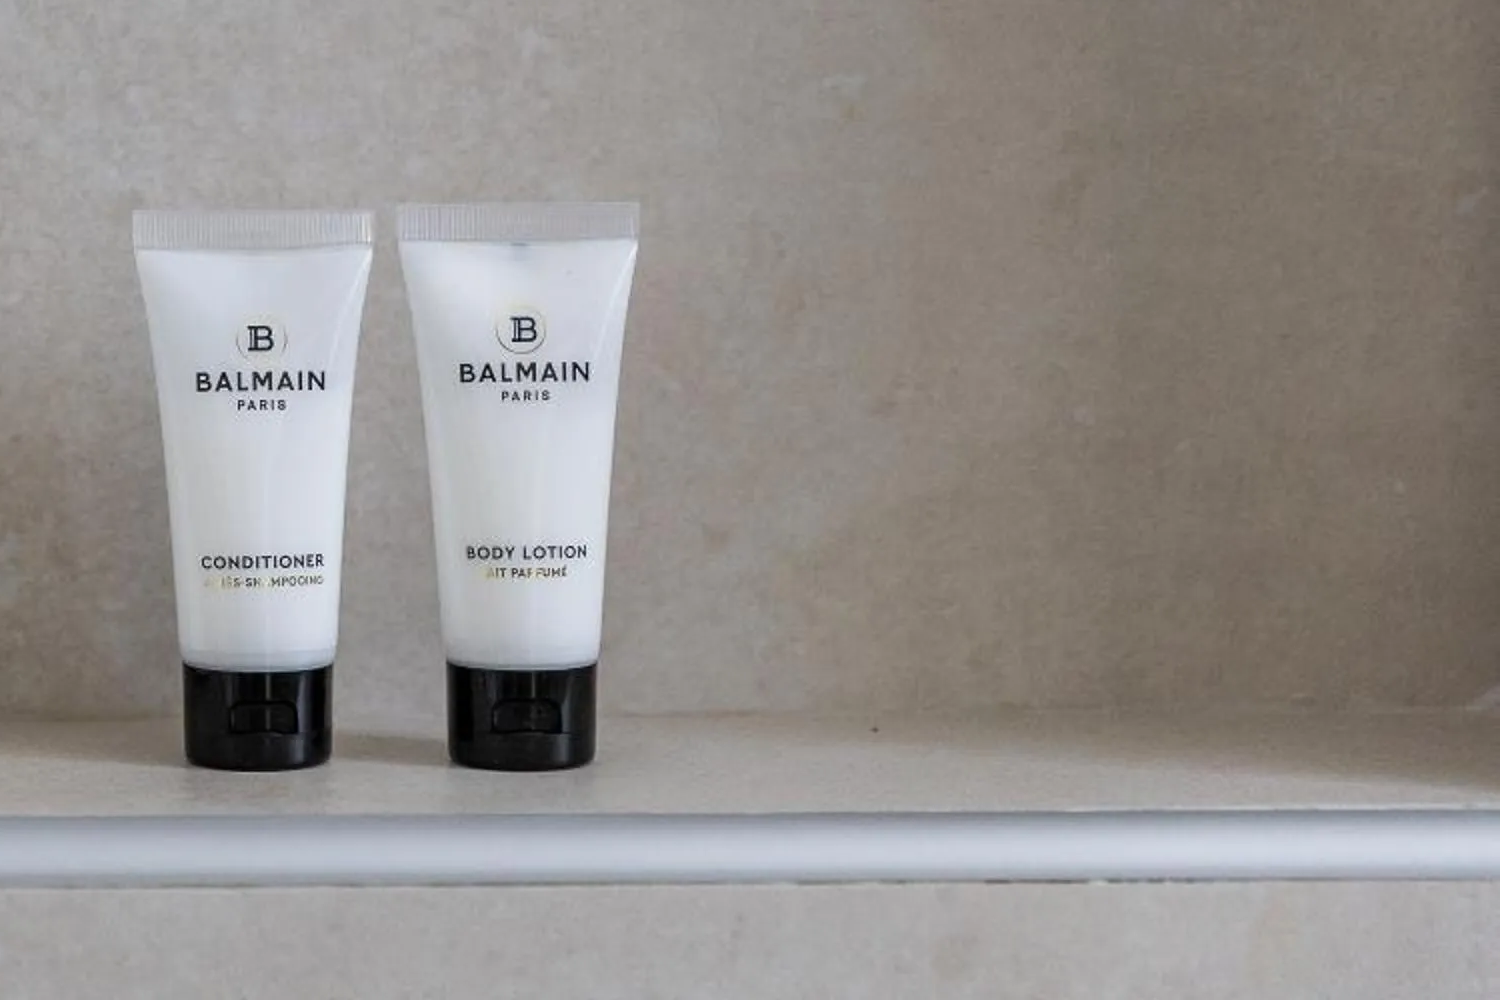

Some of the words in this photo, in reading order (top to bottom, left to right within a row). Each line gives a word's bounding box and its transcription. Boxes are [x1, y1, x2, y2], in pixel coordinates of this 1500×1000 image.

[459, 361, 590, 384] BALMAIN
[196, 370, 326, 393] BALMAIN
[501, 389, 551, 402] PARIS
[237, 399, 287, 411] PARIS
[467, 545, 515, 560] BODY
[522, 544, 587, 560] LOTION
[201, 553, 325, 571] CONDITIONER
[479, 567, 507, 579] AIT
